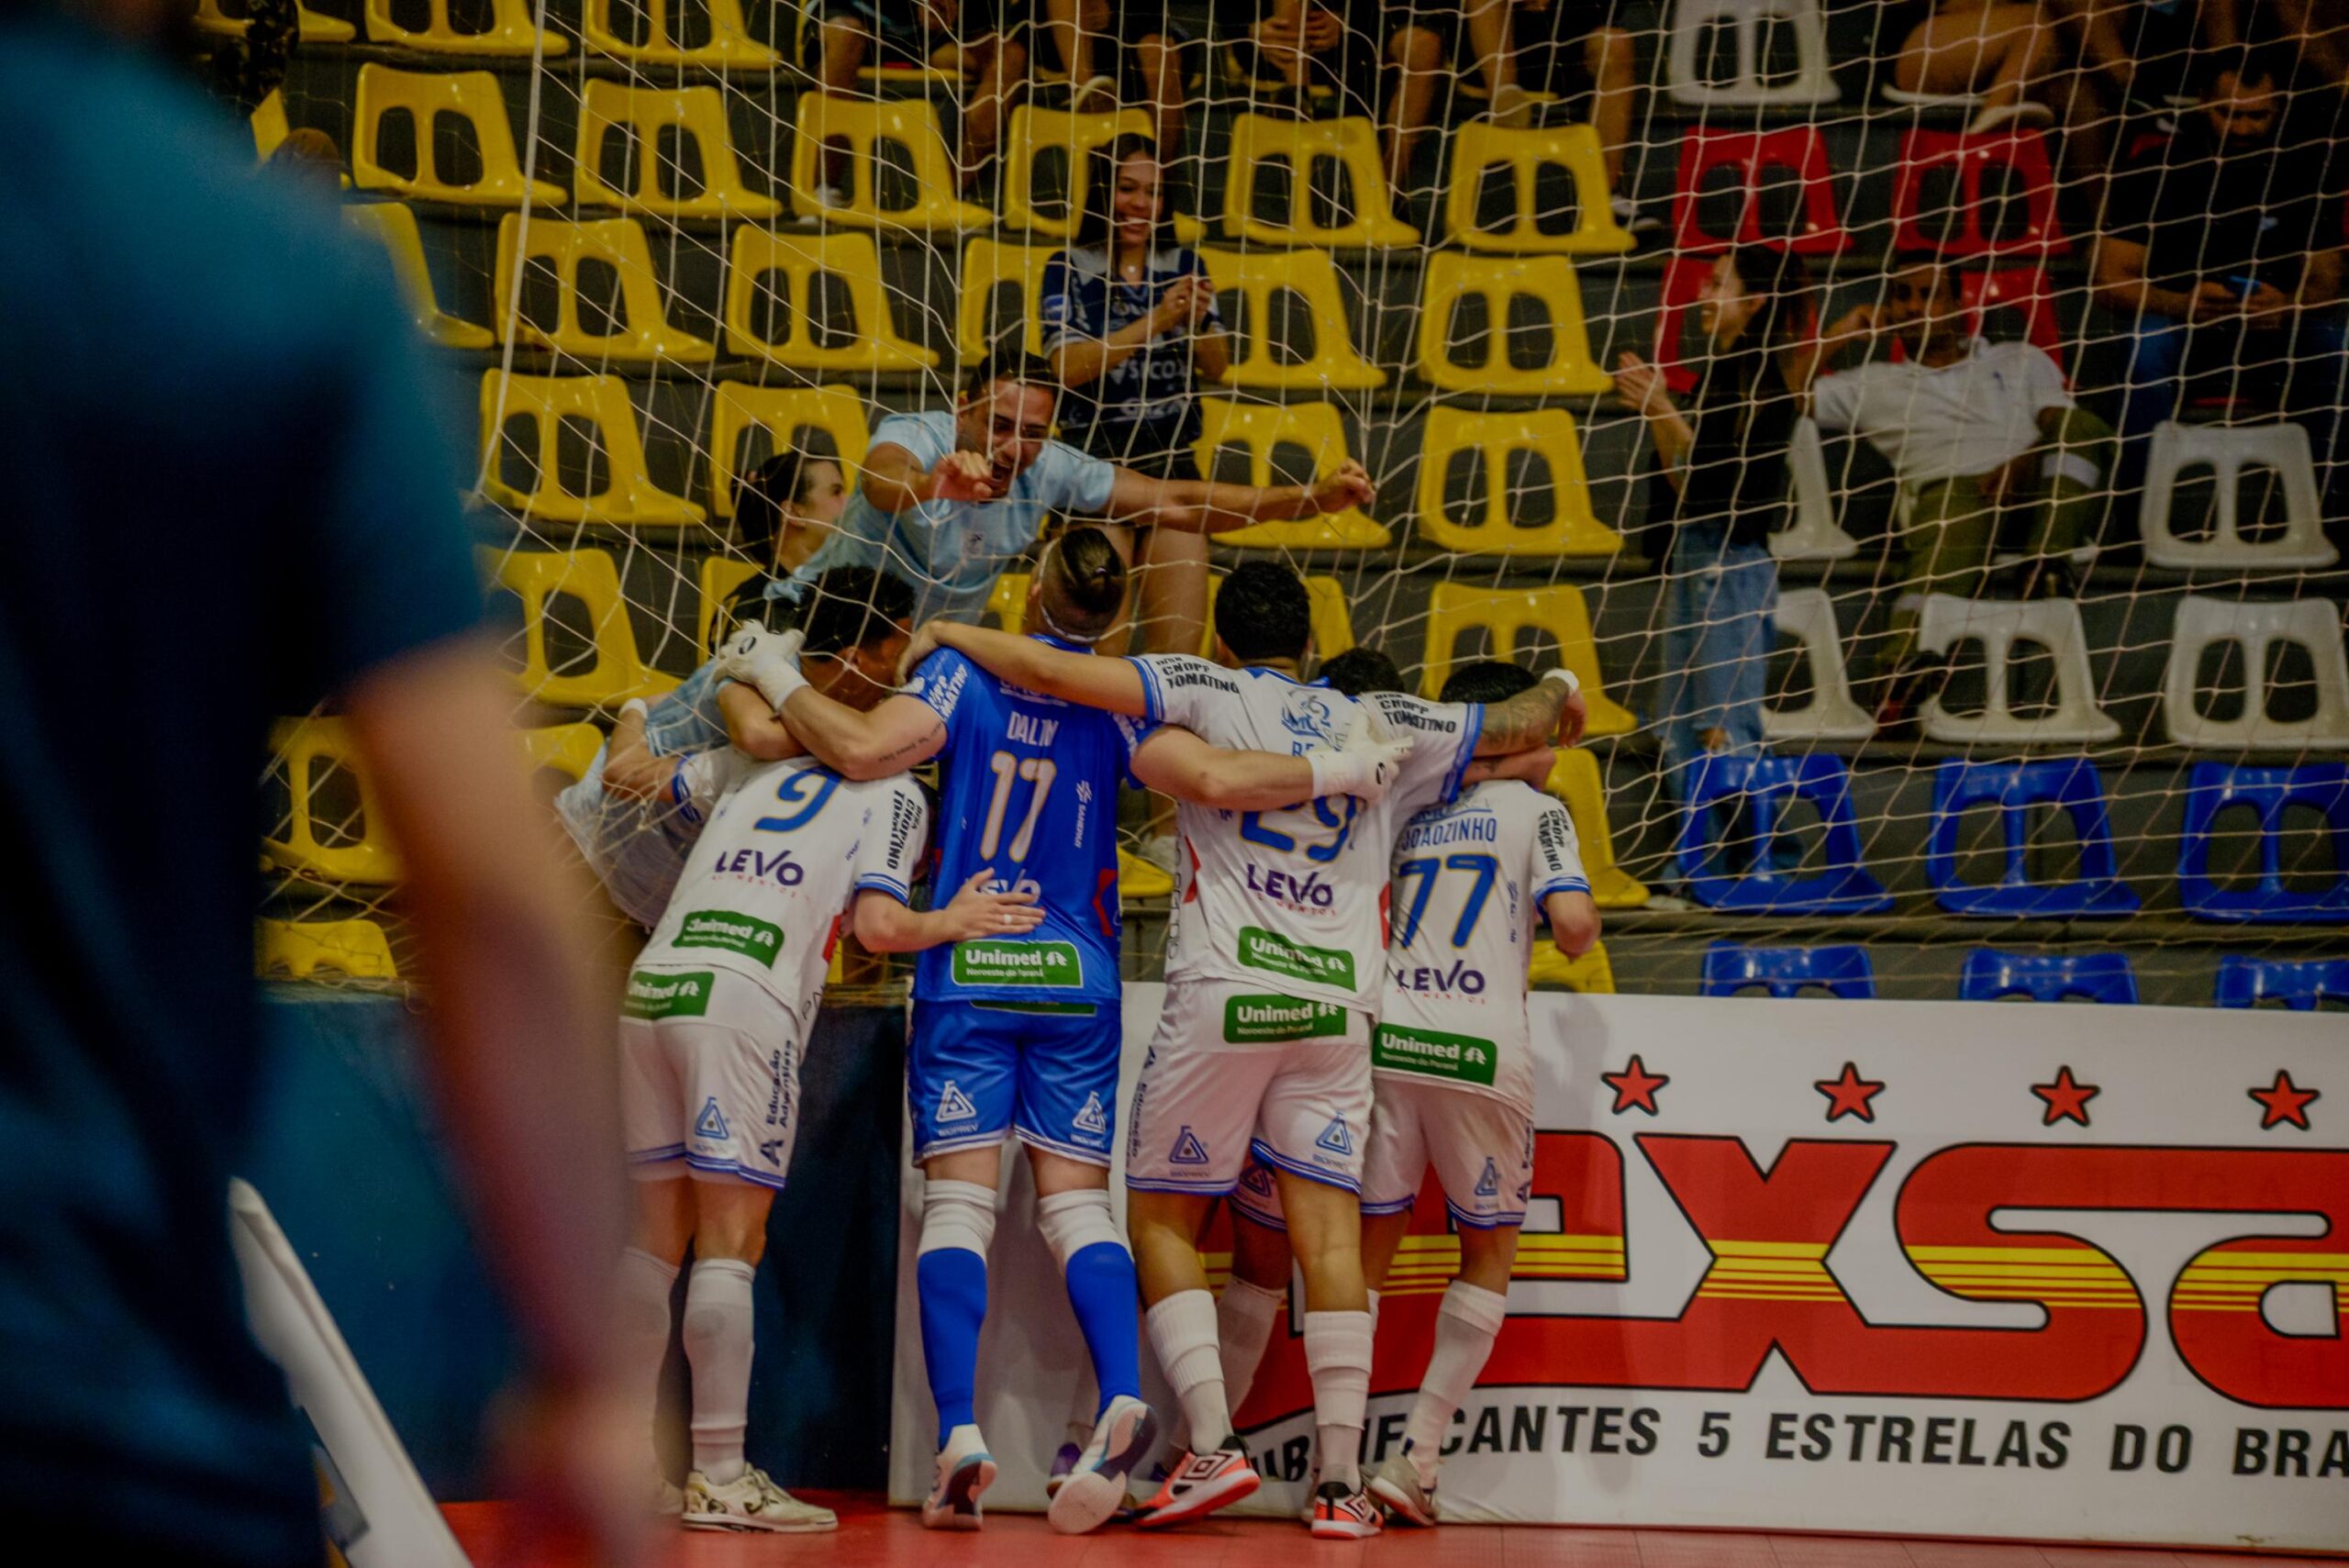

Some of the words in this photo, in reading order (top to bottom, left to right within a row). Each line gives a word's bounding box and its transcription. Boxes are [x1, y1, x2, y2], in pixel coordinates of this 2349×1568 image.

[753, 768, 846, 832] 9
[980, 751, 1057, 862] 17
[714, 849, 805, 886] LEVO
[1247, 862, 1334, 907] LEVO
[1397, 854, 1499, 951] 77
[964, 948, 1043, 966] Unimed
[1397, 959, 1486, 995] LEVO
[1236, 1002, 1314, 1023] Unimed
[1380, 1032, 1461, 1061] Unimed
[1698, 1411, 1731, 1458] 5
[1765, 1413, 2072, 1470] ESTRELAS
[2110, 1423, 2193, 1474] DO
